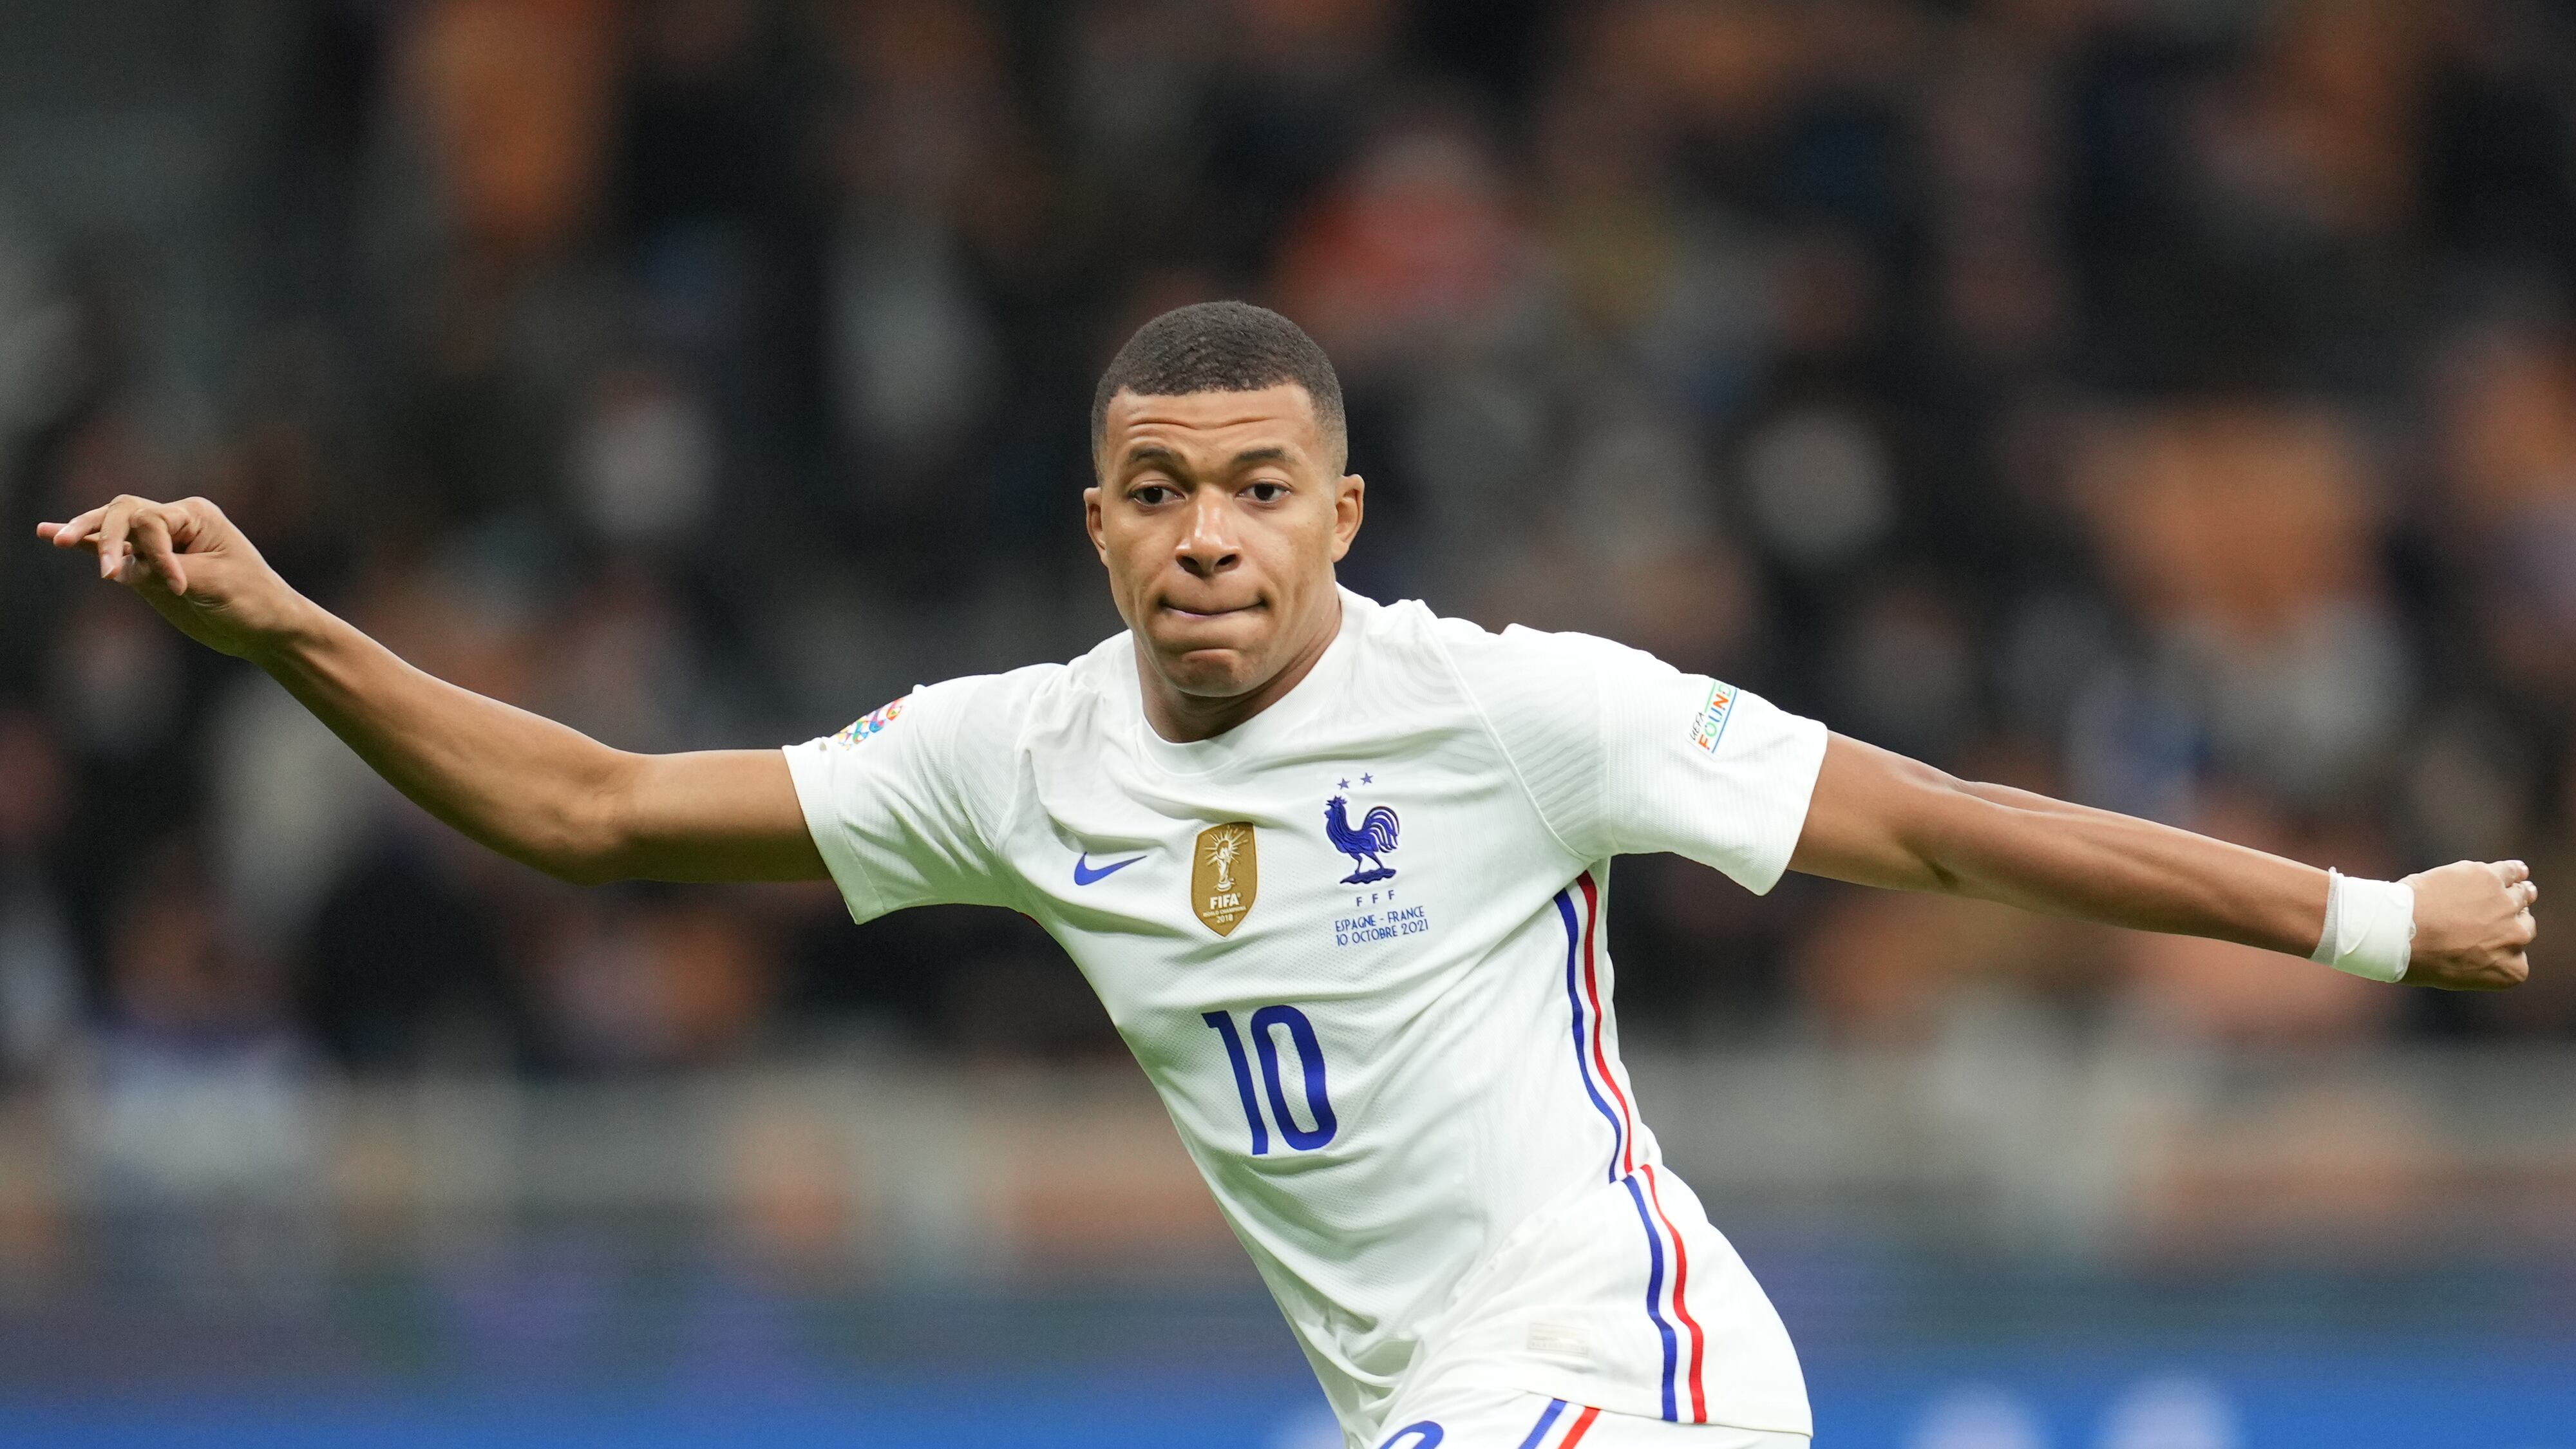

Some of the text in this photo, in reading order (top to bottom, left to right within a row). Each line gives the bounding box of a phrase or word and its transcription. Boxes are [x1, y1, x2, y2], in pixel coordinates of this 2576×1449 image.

[1690, 712, 1704, 741] UEFA
[1217, 913, 1233, 923] 2018
[1335, 914, 1376, 932] ESPAGNE
[1387, 905, 1425, 923] FRANCE
[1336, 919, 1428, 946] 10 OCTOBRE 2021
[1201, 1005, 1337, 1155] 10
